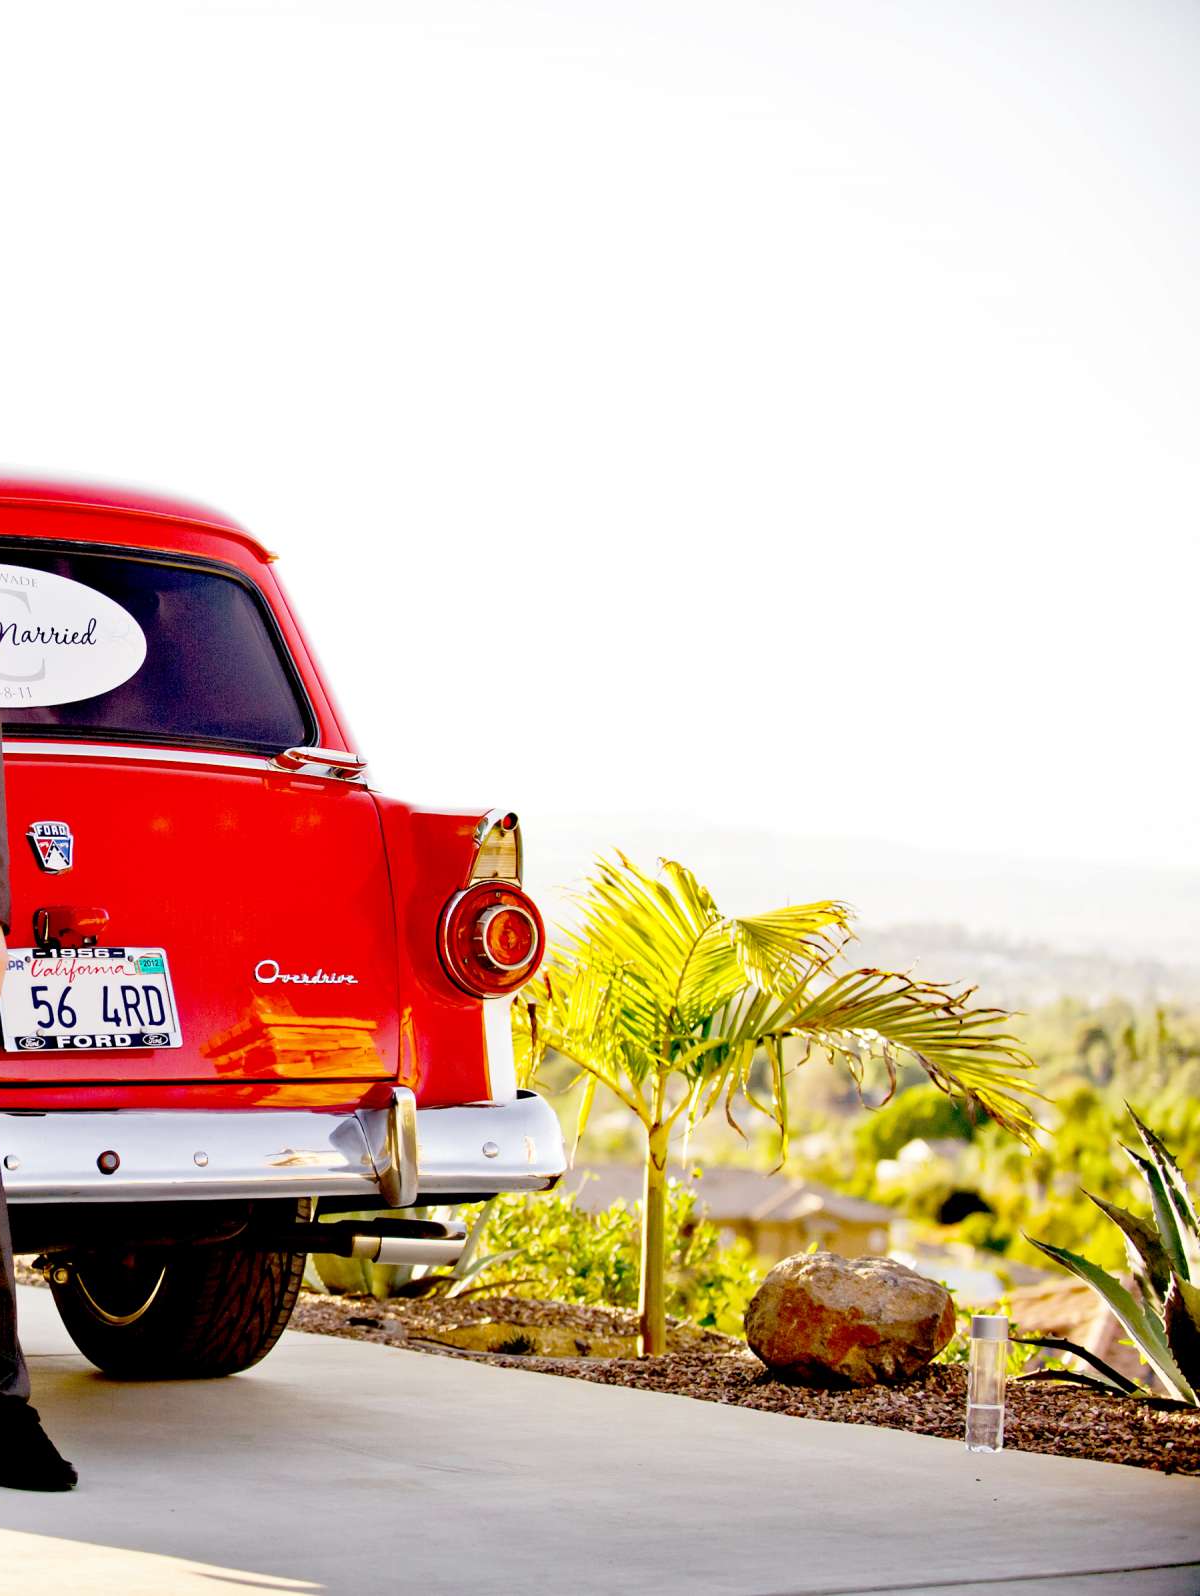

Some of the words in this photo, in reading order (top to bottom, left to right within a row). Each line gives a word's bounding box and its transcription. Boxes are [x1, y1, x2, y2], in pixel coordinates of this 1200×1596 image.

[36, 825, 65, 835] FORD
[31, 958, 136, 983] California
[255, 959, 359, 984] Overdrive
[31, 985, 77, 1028] 56
[103, 985, 166, 1027] 4RD
[56, 1035, 132, 1048] FORD
